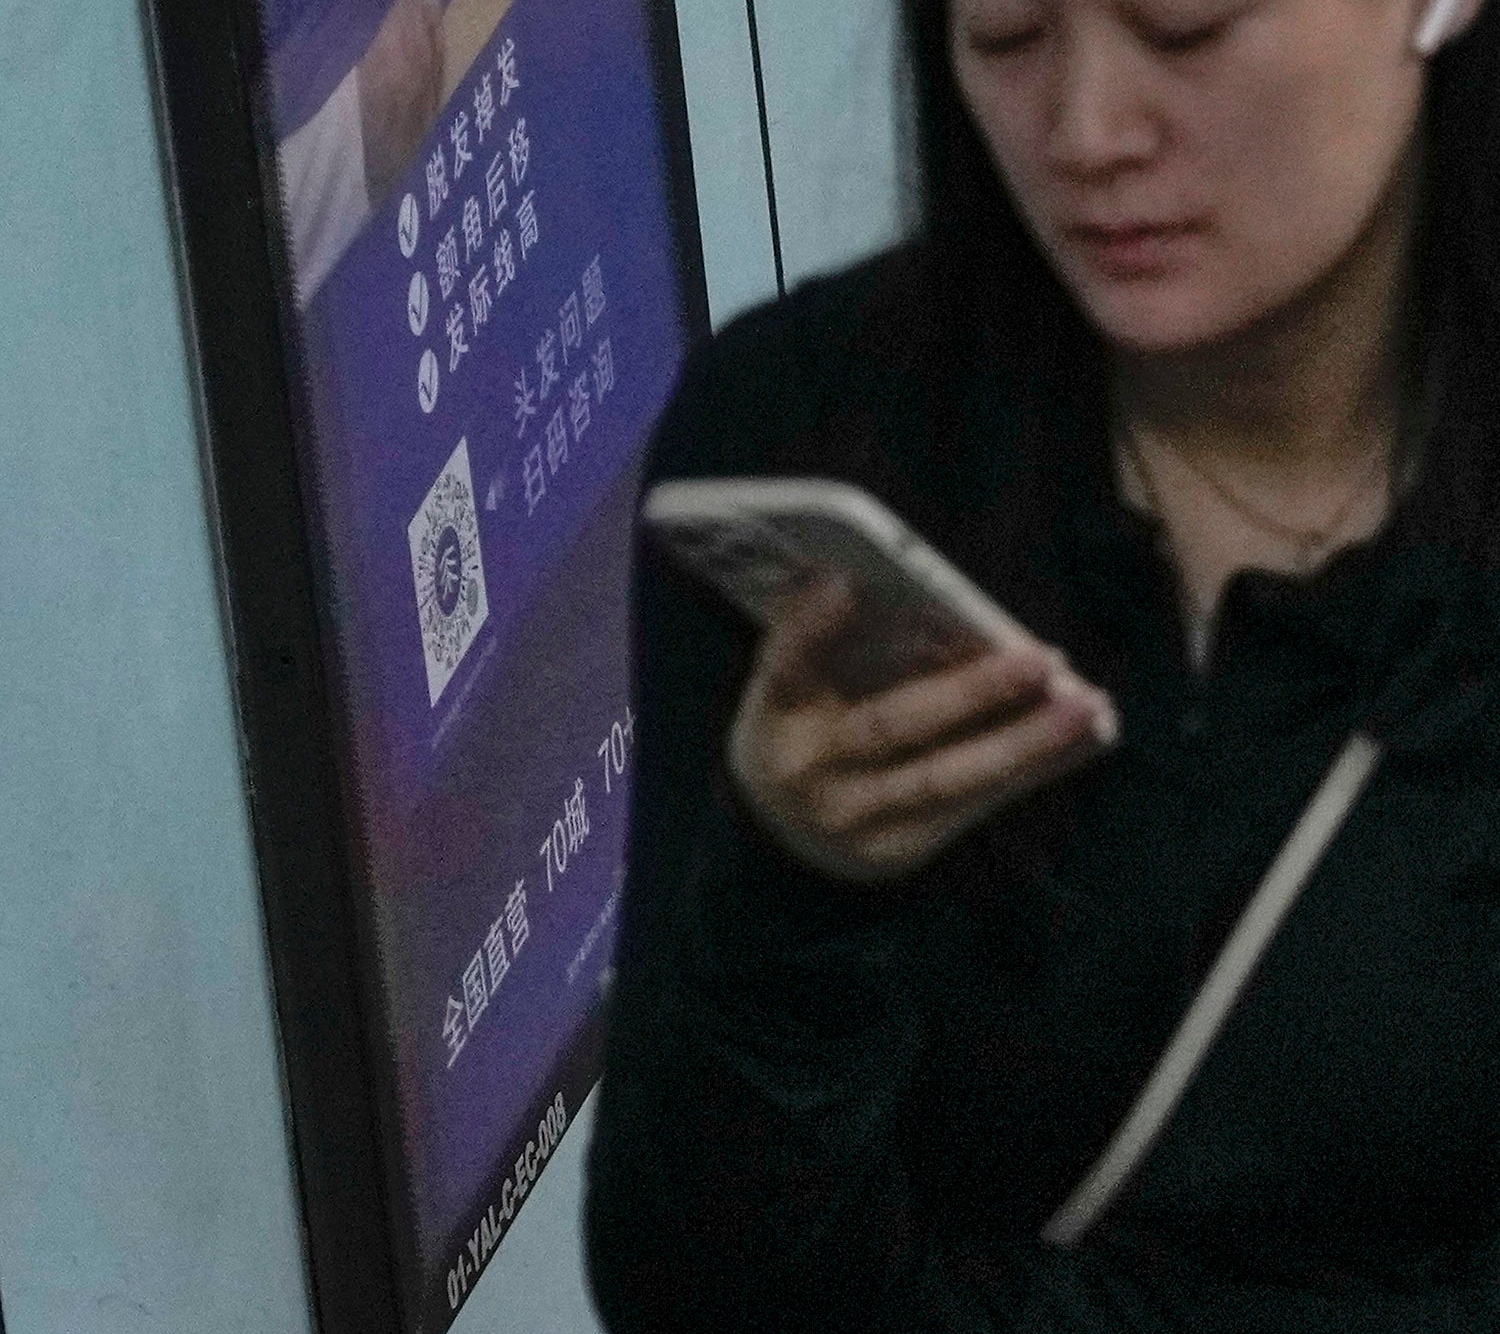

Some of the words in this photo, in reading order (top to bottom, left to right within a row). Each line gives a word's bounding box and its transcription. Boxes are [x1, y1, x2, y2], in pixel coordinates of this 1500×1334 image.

[426, 38, 519, 221] 脱发掉发
[437, 117, 530, 300] 额角后移
[446, 189, 539, 373] 发际线高
[514, 253, 606, 439] 头发问题
[523, 338, 613, 517] 扫码咨询
[442, 878, 530, 1069] 全国直营
[539, 777, 590, 892] 70城
[447, 1092, 566, 1309] 01-YAL-C-EC-008
